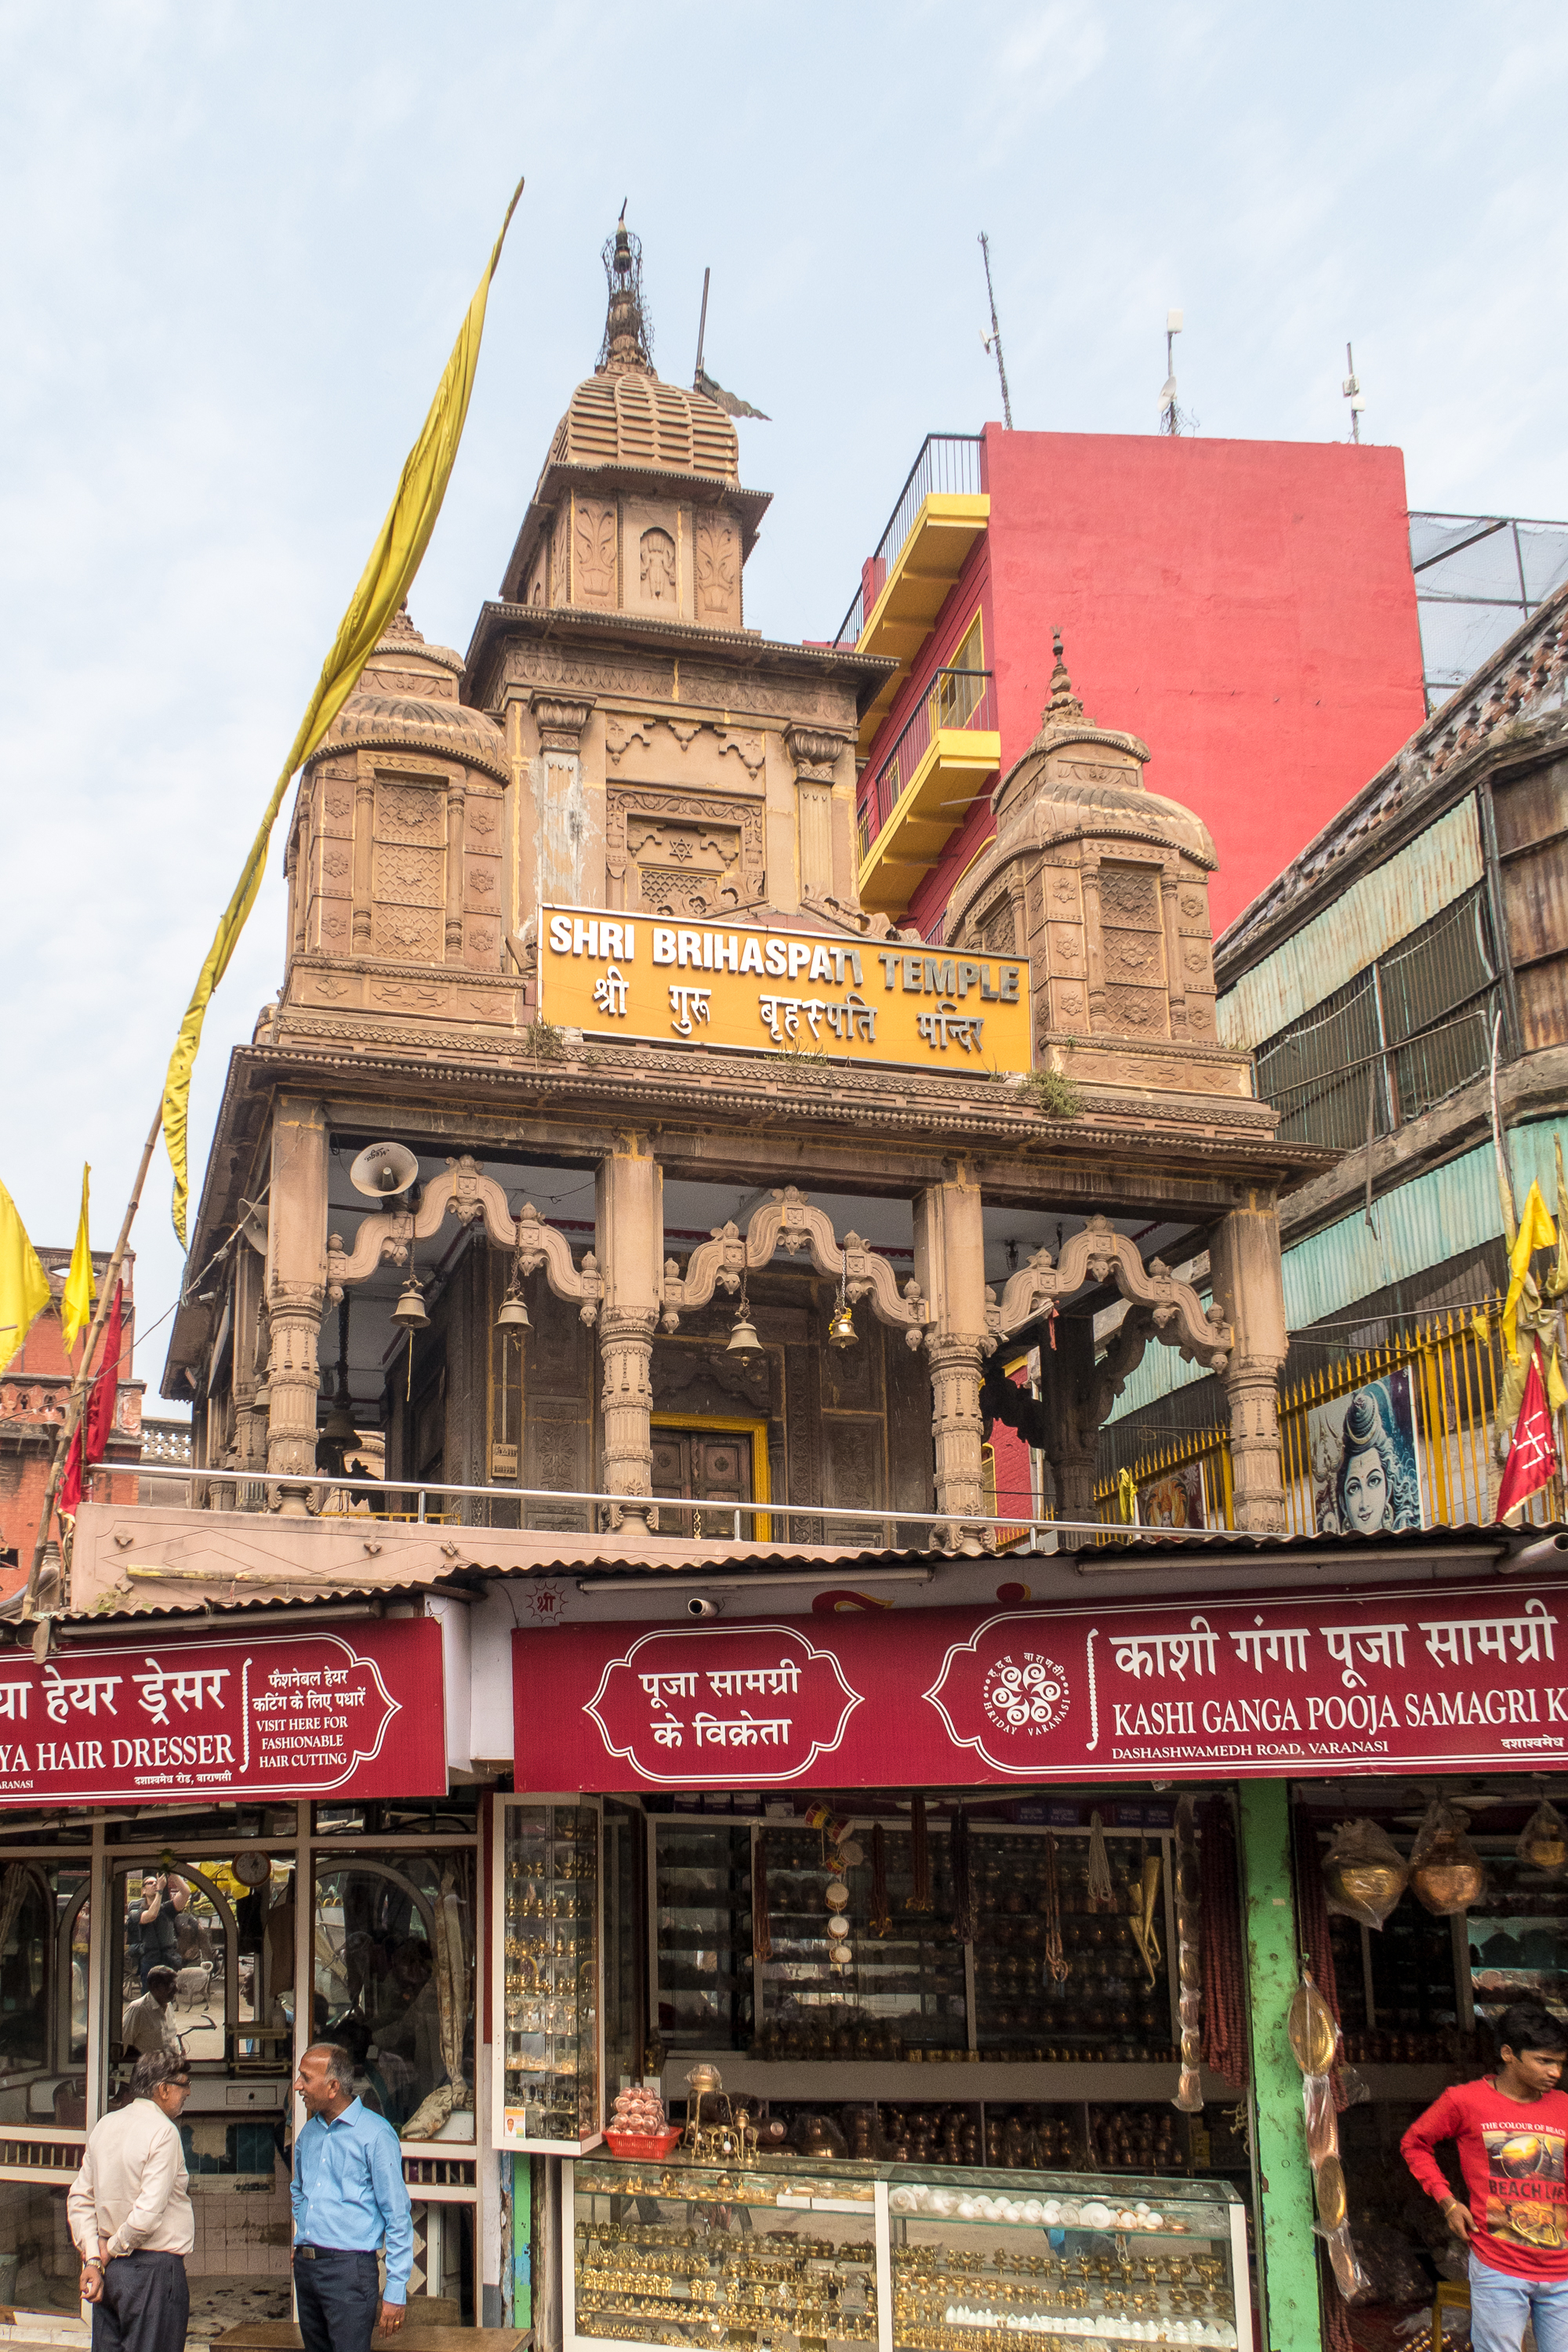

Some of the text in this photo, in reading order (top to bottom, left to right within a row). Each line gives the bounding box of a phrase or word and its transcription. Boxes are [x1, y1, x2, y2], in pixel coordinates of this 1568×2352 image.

[549, 915, 1020, 1004] SHRI BRIHASPATI TEMPLE
[592, 965, 630, 1018] श्री
[758, 991, 878, 1044] बृहस्पति
[916, 1000, 985, 1054] मन्दिर
[537, 1592, 556, 1613] श्री
[1109, 1599, 1559, 1688] काशी गंगा पूजा सामग्री
[1024, 1653, 1064, 1676] वाराणसी
[267, 1665, 349, 1689] फैशनेबल हेयर
[638, 1659, 802, 1708] पूजा सामग्री
[41, 1664, 123, 1724] हेयर
[132, 1658, 230, 1725] ड्रेसर
[252, 1686, 366, 1712] कटिंग के लिए पधारें
[256, 1716, 348, 1732] VISIT HERE FOR
[984, 1699, 1070, 1736] HRIDAY VARANASI
[1112, 1702, 1196, 1735] KASHI
[1202, 1698, 1302, 1733] GANGA
[1305, 1694, 1401, 1735] POOJA
[1404, 1689, 1541, 1726] SAMAGRI
[650, 1710, 793, 1748] के विक्रेता
[36, 1741, 106, 1771] HAIR
[111, 1734, 235, 1768] DRESSER
[262, 1734, 343, 1750] FASHIONABLE
[1112, 1740, 1388, 1759] DASHASHWAMEDH ROAD, VARANASI
[1501, 1734, 1564, 1749] दशाश्वमेध
[260, 1752, 347, 1768] HAIR CUTTING
[134, 1773, 173, 1785] दशाश्वमेध
[196, 1769, 232, 1783] वाराणसी
[1481, 2122, 1497, 2131] THE
[1498, 2122, 1534, 2131] COLOUR
[1534, 2123, 1544, 2132] OF
[1489, 2180, 1541, 2198] BEACH
